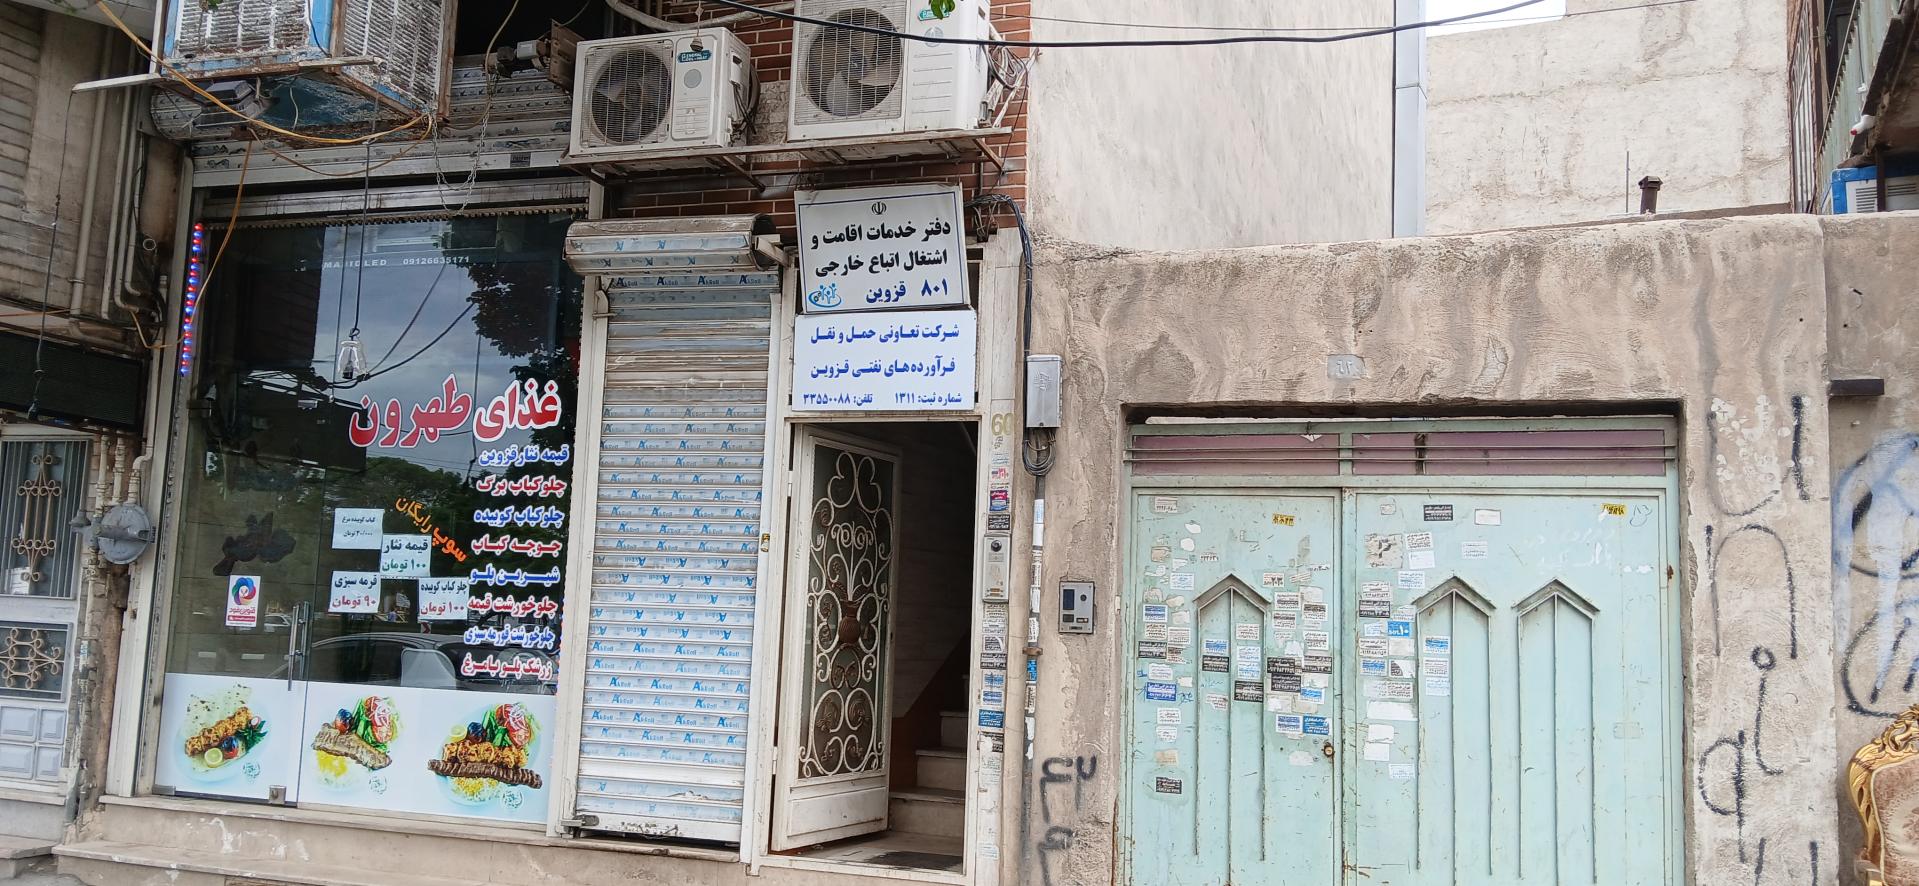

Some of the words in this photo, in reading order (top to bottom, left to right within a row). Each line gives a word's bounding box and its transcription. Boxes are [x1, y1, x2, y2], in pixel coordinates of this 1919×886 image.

[823, 224, 863, 244] اقامت
[866, 221, 916, 240] خدمات
[922, 218, 951, 241] دفتر
[811, 235, 819, 249] و
[815, 254, 864, 277] خارجی
[868, 251, 900, 274] اتباع
[903, 249, 948, 271] اشتغال
[866, 281, 907, 303] قزوین
[921, 278, 948, 297] ۸۰۱
[810, 326, 836, 344] نقل
[838, 332, 844, 344] و
[846, 325, 876, 343] حمل
[879, 324, 920, 343] تعاونی
[921, 324, 960, 342] شرکت
[810, 359, 850, 379] قزوین
[852, 360, 882, 377] نفتی
[853, 393, 873, 406] تلفن:
[895, 392, 915, 404] ۱۳۱۱
[938, 393, 962, 406] شماره
[349, 374, 473, 448] طهرون
[473, 378, 562, 442] غذای
[479, 444, 518, 466] قزوین
[515, 445, 539, 466] نثار
[541, 444, 570, 465] قیمه
[476, 474, 508, 496] برگ
[395, 498, 432, 533] رایگان
[474, 506, 514, 527] کوبیده
[383, 539, 402, 553] نثار
[405, 540, 428, 554] قیمه
[432, 527, 468, 562] سوپ
[471, 533, 510, 555] کباب
[509, 538, 562, 557] جوجه
[382, 558, 408, 572] تومان
[411, 560, 426, 569] ۱۰۰
[334, 576, 357, 588] سبزی
[360, 576, 378, 589] قرمه
[469, 563, 496, 586] پلو
[495, 566, 560, 587] شیرین
[332, 596, 361, 608] تومان
[364, 595, 376, 606] ۹۰
[420, 602, 446, 615] تومان
[449, 601, 465, 613] ۱۰۰
[467, 592, 492, 615] قیمه
[464, 626, 489, 645] سبزی
[499, 656, 522, 679] پلو
[522, 656, 553, 680] زرشک
